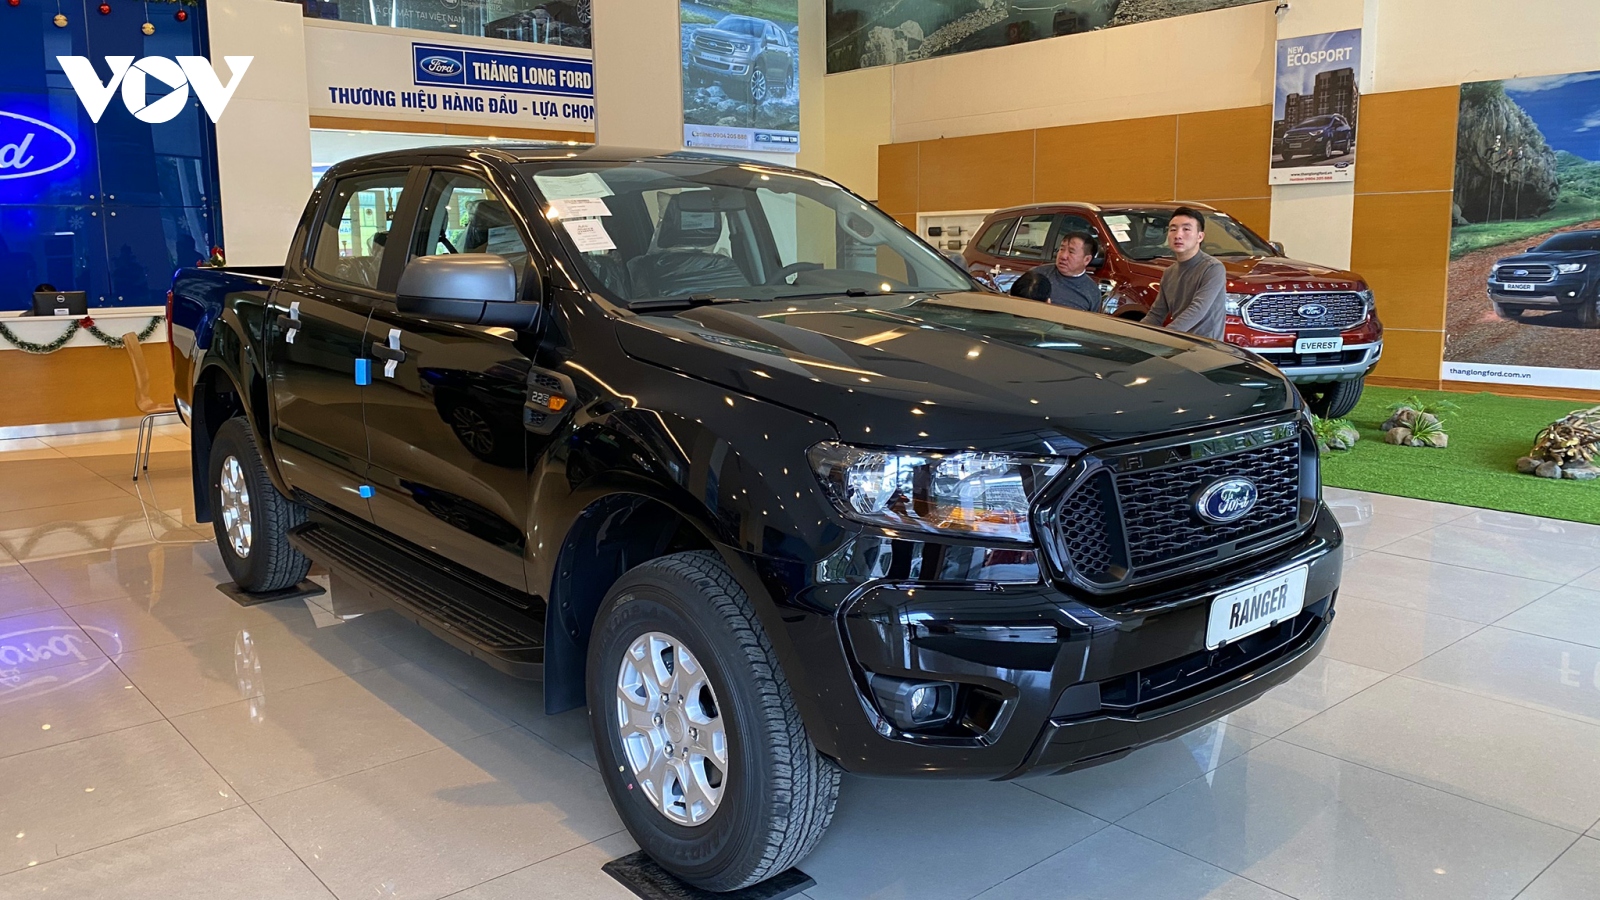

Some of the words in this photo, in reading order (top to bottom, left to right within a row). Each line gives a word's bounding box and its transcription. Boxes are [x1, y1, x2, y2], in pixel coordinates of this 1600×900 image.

[415, 10, 428, 20] TẠI
[428, 11, 447, 23] VIỆT
[447, 14, 466, 24] NAM
[1286, 47, 1353, 67] ECOSPORT
[1287, 46, 1304, 55] NEW
[428, 58, 455, 74] Ford
[473, 60, 519, 84] THĂNG
[522, 66, 556, 87] LONG
[559, 70, 592, 90] FORD
[328, 86, 396, 107] THƯƠNG
[401, 89, 437, 112] HIỆU
[442, 92, 484, 112] HÀNG
[488, 93, 518, 115] ĐẦU
[532, 100, 559, 120] LỰA
[1300, 341, 1338, 350] EVEREST
[1449, 367, 1532, 379] thanglongford.com.vn
[1228, 583, 1289, 631] RANGER
